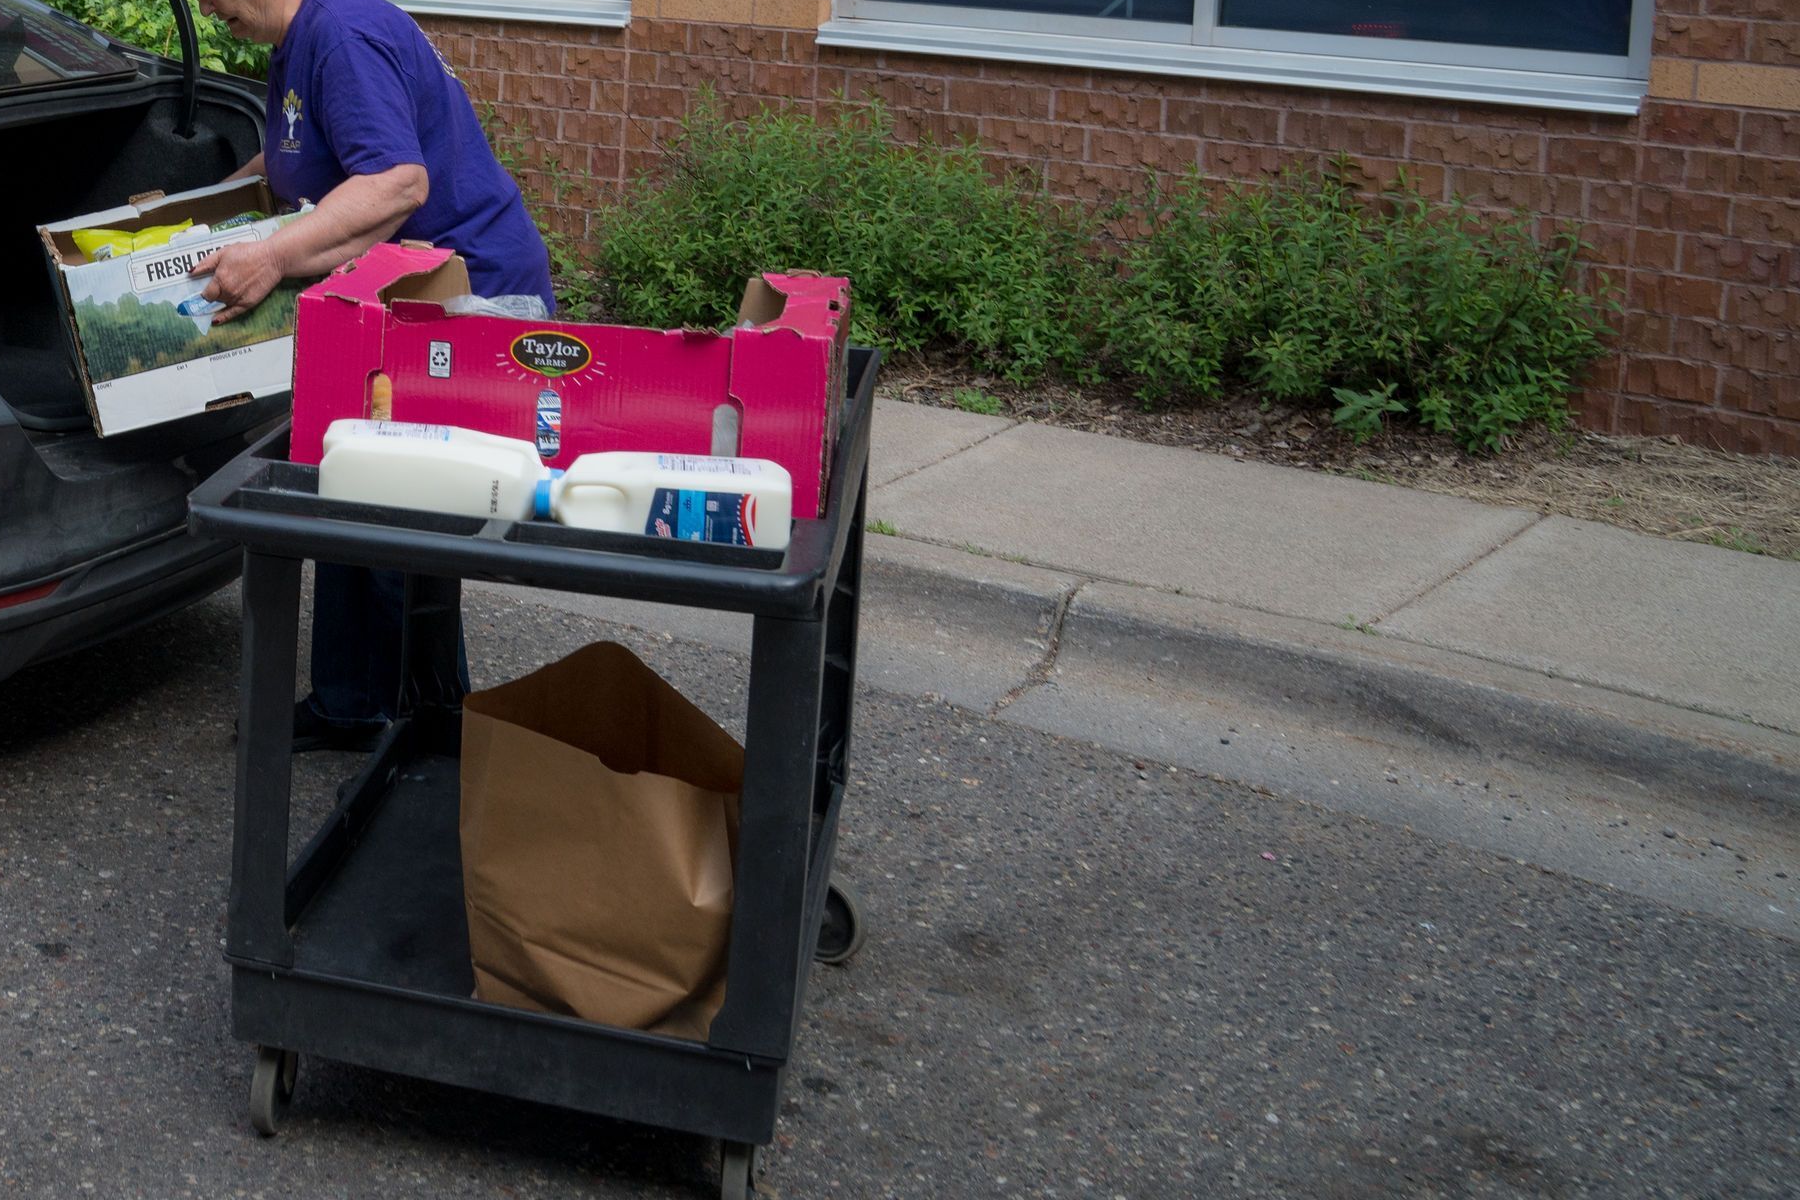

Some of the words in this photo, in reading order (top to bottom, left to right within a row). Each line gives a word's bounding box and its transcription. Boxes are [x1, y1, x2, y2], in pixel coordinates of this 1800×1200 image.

[145, 253, 196, 282] FRESH
[523, 338, 580, 358] Taylor
[534, 357, 567, 367] FARMS
